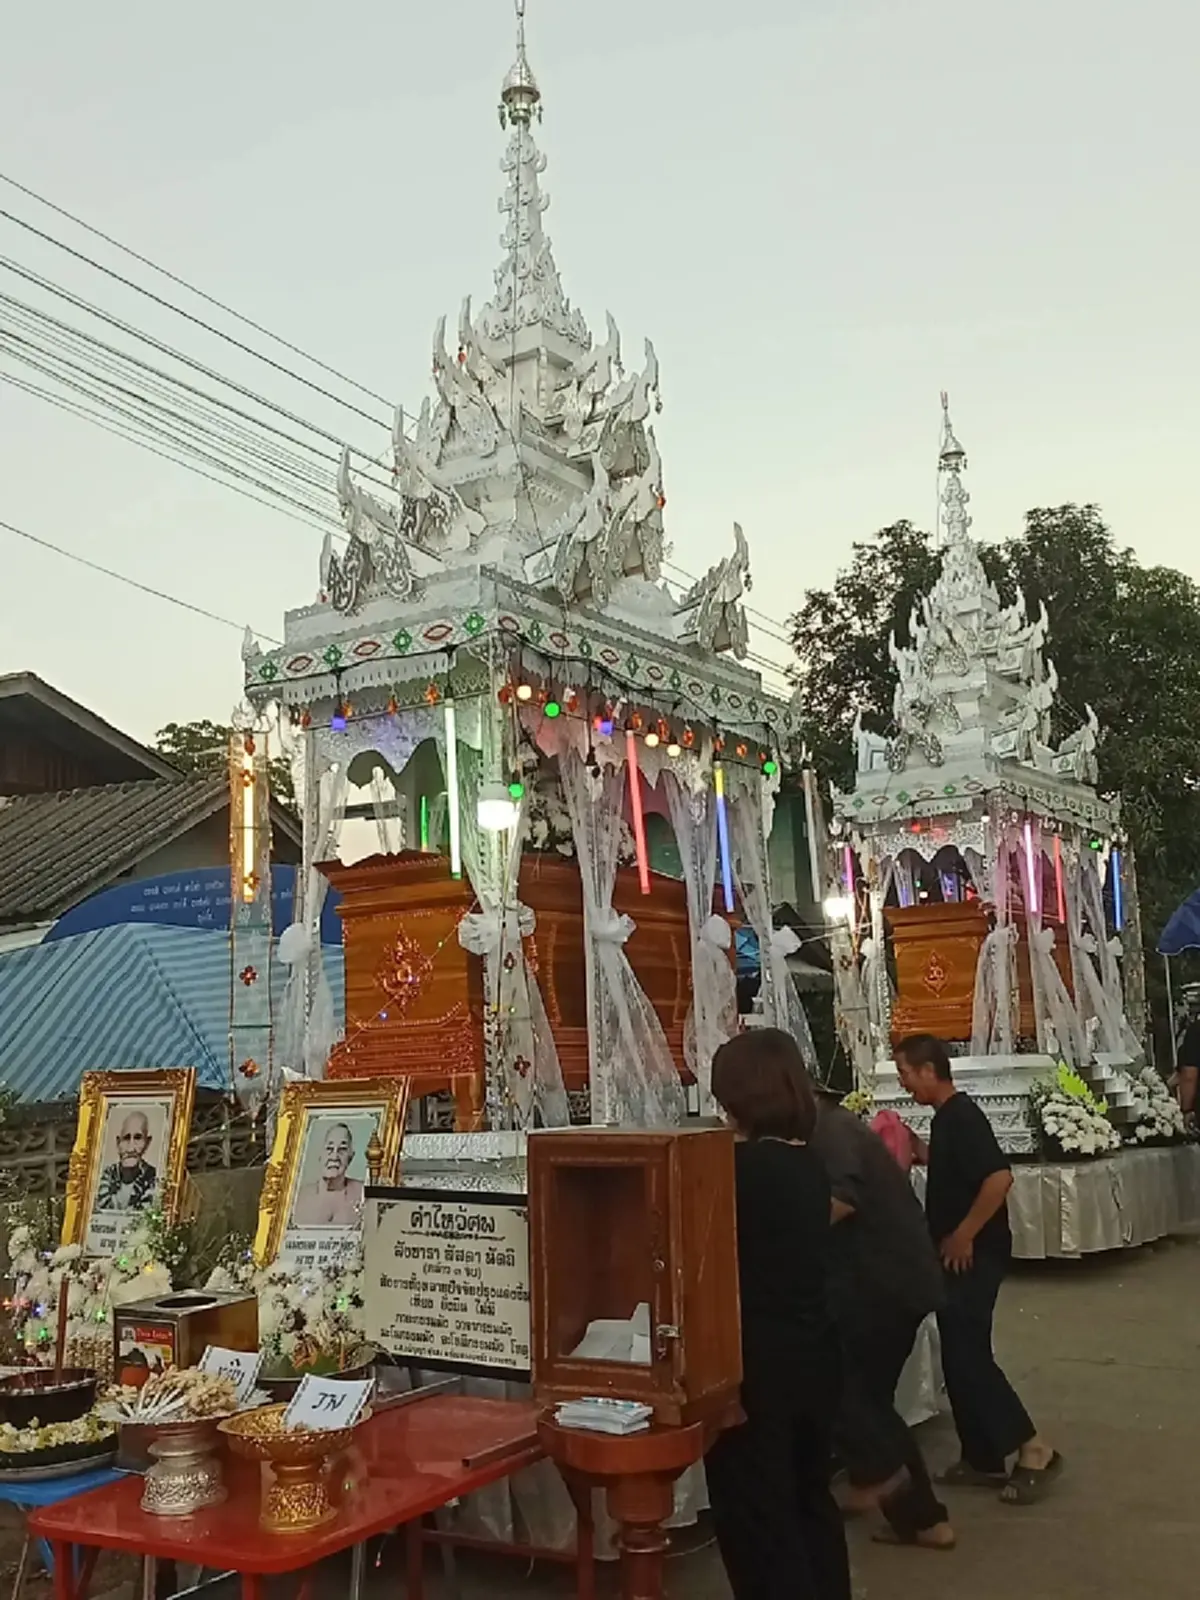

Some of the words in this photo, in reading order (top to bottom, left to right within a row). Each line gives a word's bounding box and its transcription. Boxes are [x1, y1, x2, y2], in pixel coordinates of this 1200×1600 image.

[410, 1204, 495, 1233] คำไหว้ศพ
[394, 1240, 440, 1261] สังขารา
